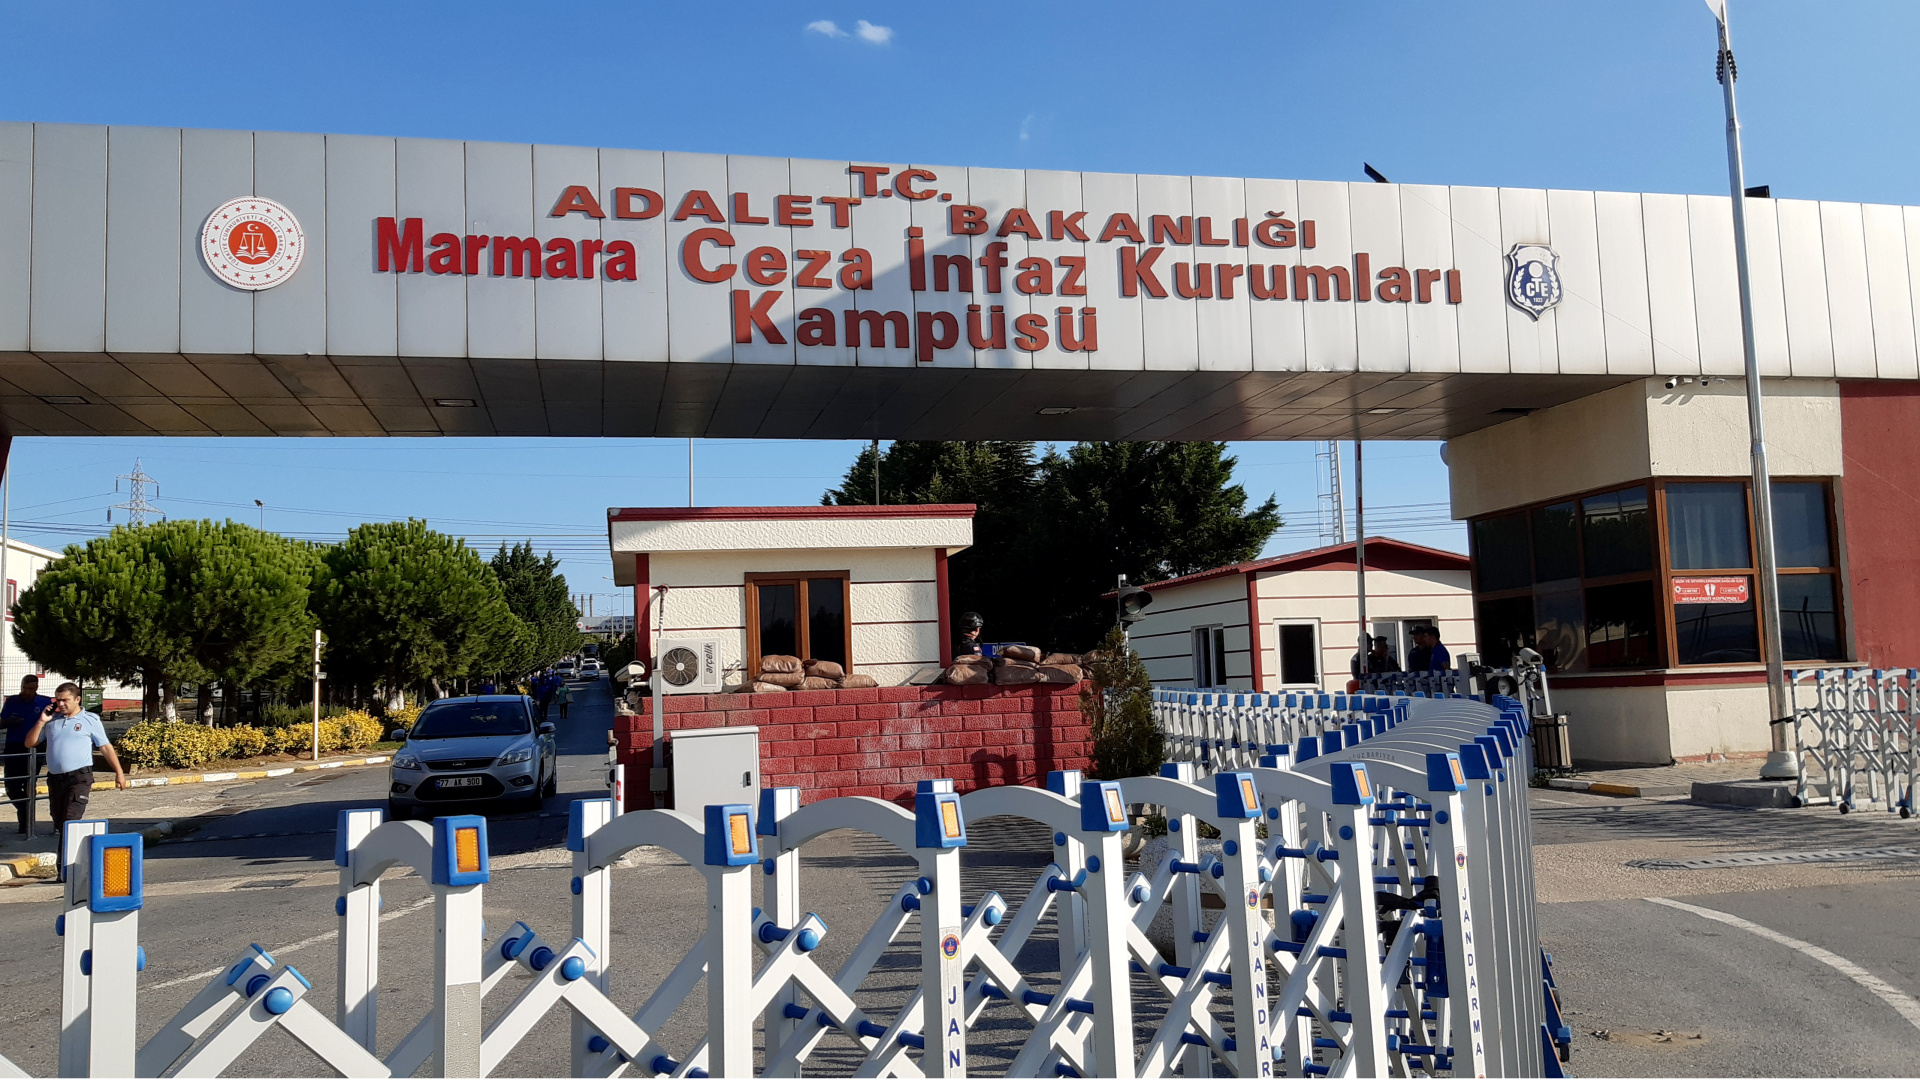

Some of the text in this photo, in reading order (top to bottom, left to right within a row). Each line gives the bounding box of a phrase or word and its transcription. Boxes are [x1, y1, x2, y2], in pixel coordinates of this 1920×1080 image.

[550, 185, 1316, 248] ADALET BAKANLIĞI
[850, 165, 952, 200] T.C.
[377, 217, 1462, 303] Marmara Ceza İnfaz Kurumları
[733, 290, 1098, 361] Kampüsü
[704, 643, 714, 674] arçelik
[440, 777, 480, 787] 77 AK 900
[1253, 931, 1271, 1077] JANDAR
[1462, 887, 1483, 1056] JANDARMA
[947, 985, 961, 1069] JAN
